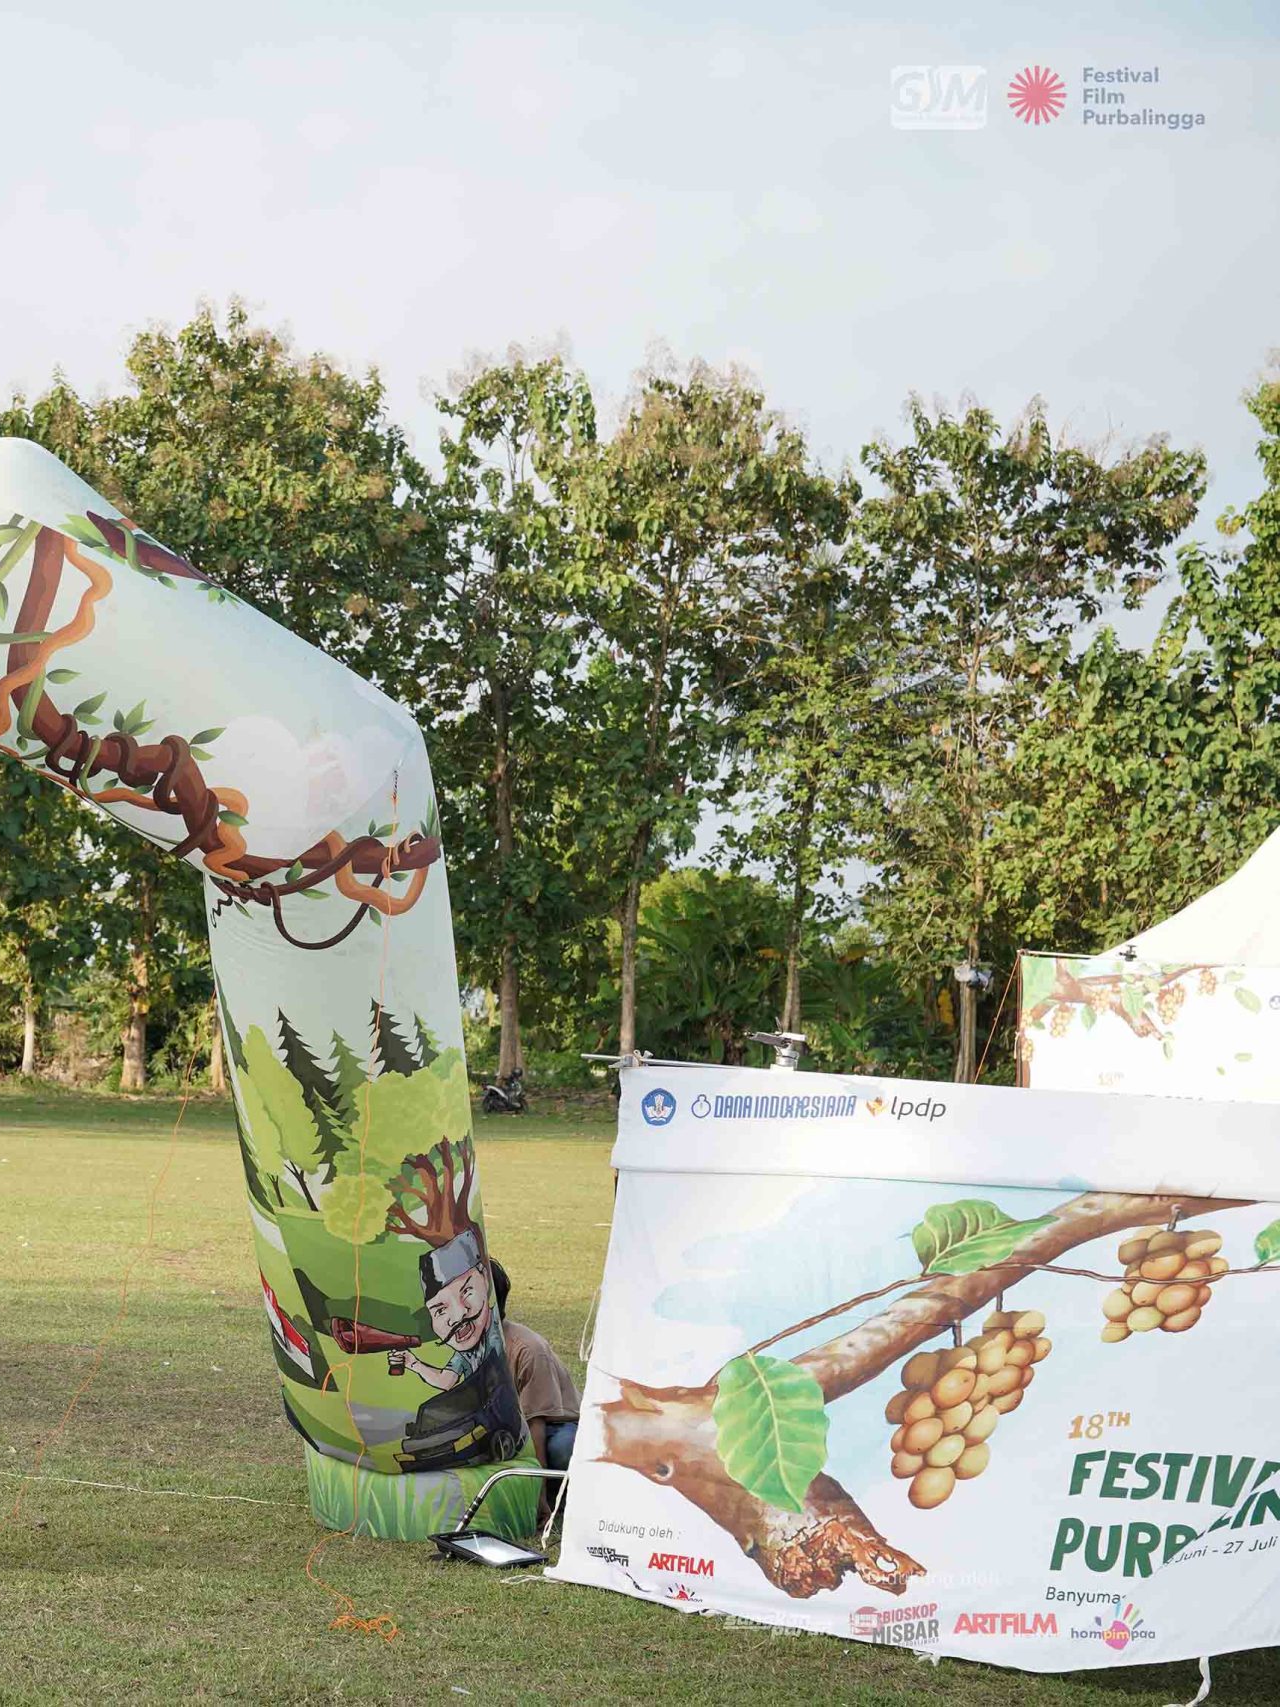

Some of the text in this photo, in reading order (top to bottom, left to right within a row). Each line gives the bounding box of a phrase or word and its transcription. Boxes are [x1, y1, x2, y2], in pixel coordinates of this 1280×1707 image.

[890, 1096, 947, 1122] lpdp
[1068, 1411, 1131, 1440] 18TH
[599, 1520, 646, 1539] Didukung
[649, 1526, 673, 1540] oleh
[1175, 1545, 1208, 1563] Juni
[1223, 1540, 1244, 1555] 27
[1248, 1536, 1278, 1553] Juli
[648, 1552, 715, 1577] ARTFILM
[1046, 1586, 1126, 1607] Banyuma
